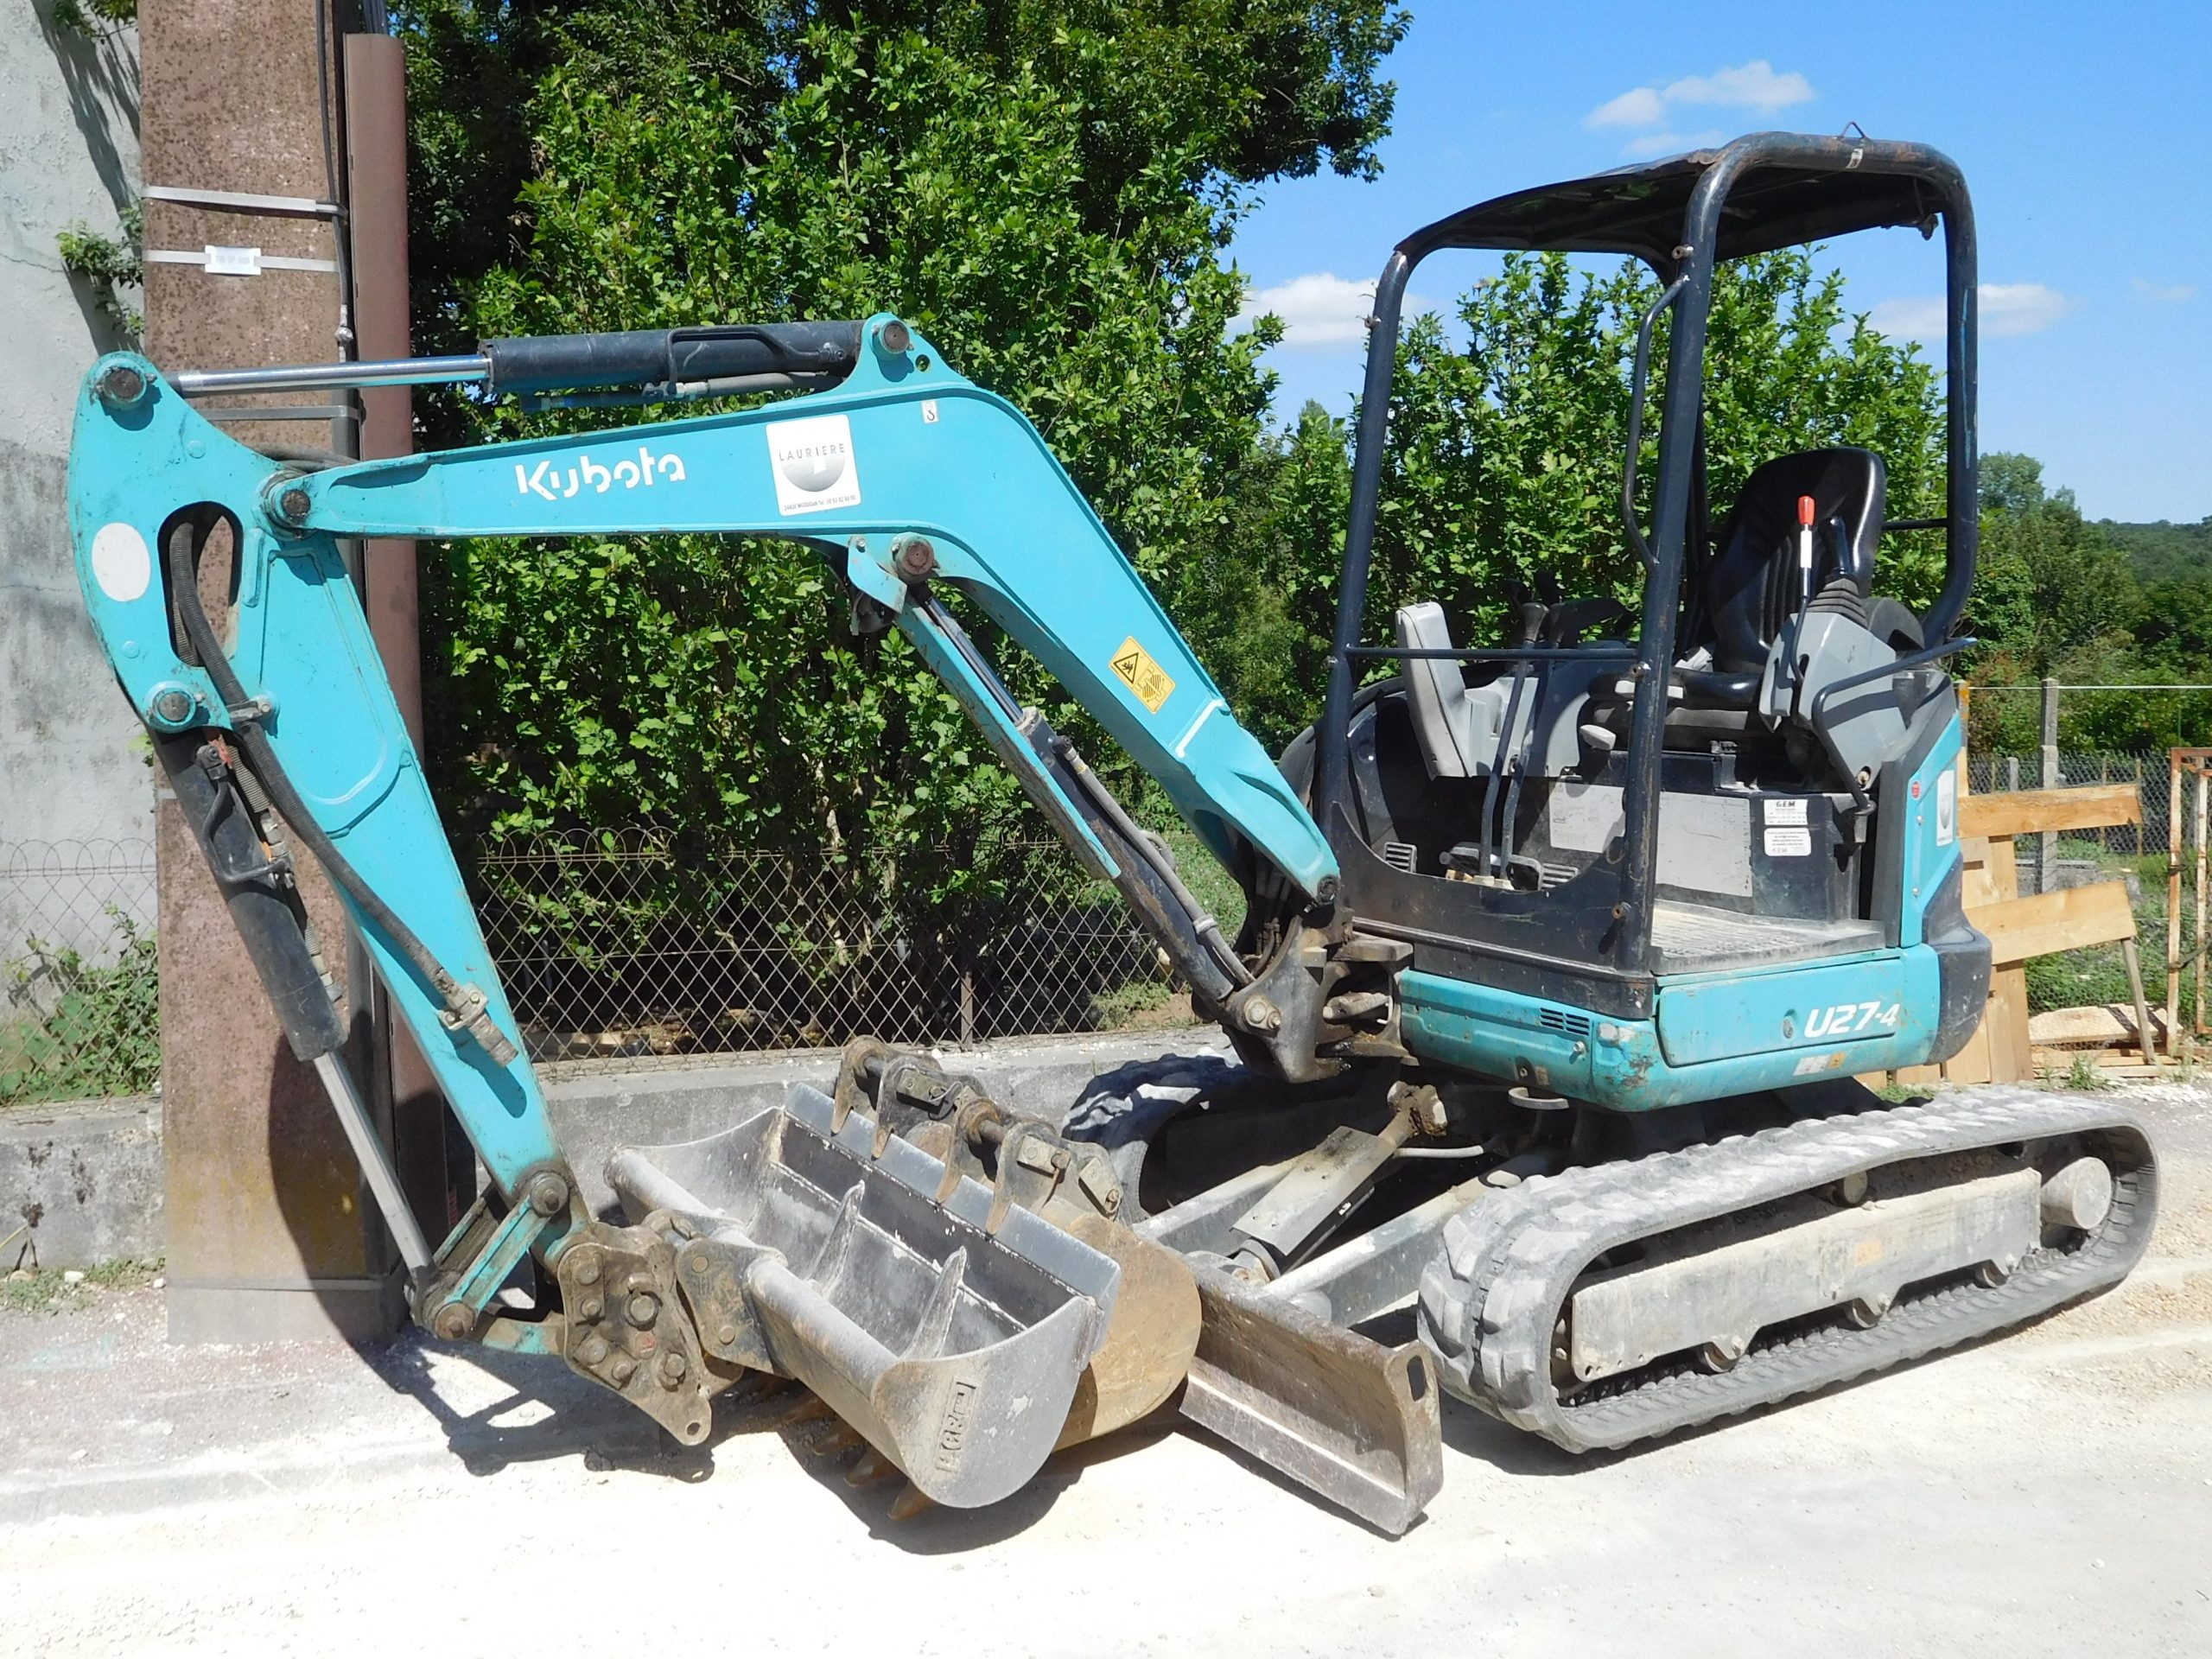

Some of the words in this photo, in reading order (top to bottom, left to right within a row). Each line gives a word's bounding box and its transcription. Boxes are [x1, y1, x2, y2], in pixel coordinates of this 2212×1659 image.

[779, 443, 845, 461] LAURIERE
[515, 447, 686, 501] Kubota
[1803, 1001, 1901, 1038] U27-4
